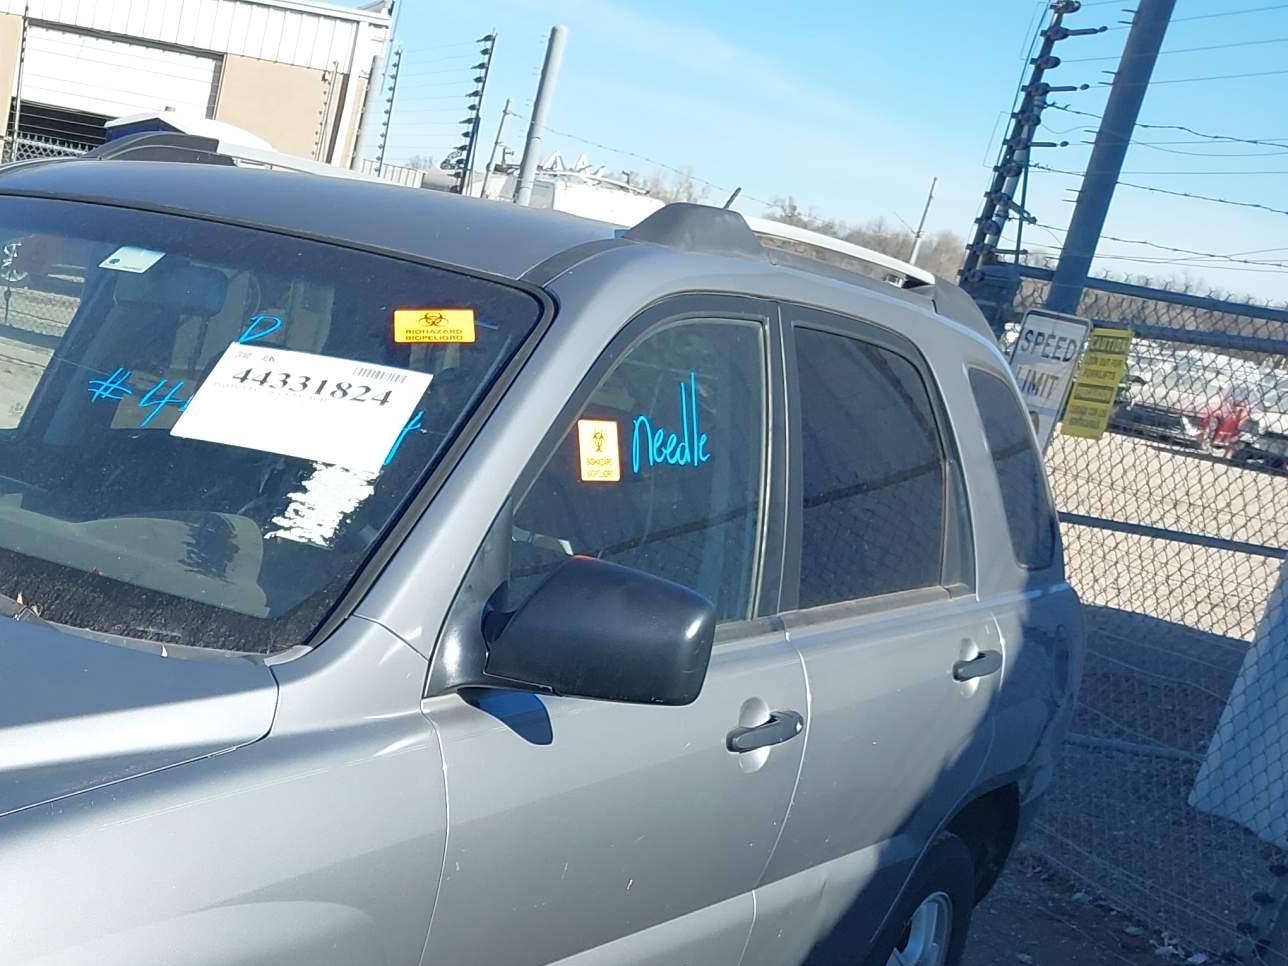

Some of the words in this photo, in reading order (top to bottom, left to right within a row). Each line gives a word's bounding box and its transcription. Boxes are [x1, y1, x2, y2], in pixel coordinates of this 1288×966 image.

[1021, 329, 1077, 362] SPEED
[88, 367, 193, 427] #4
[232, 367, 393, 407] 44331824
